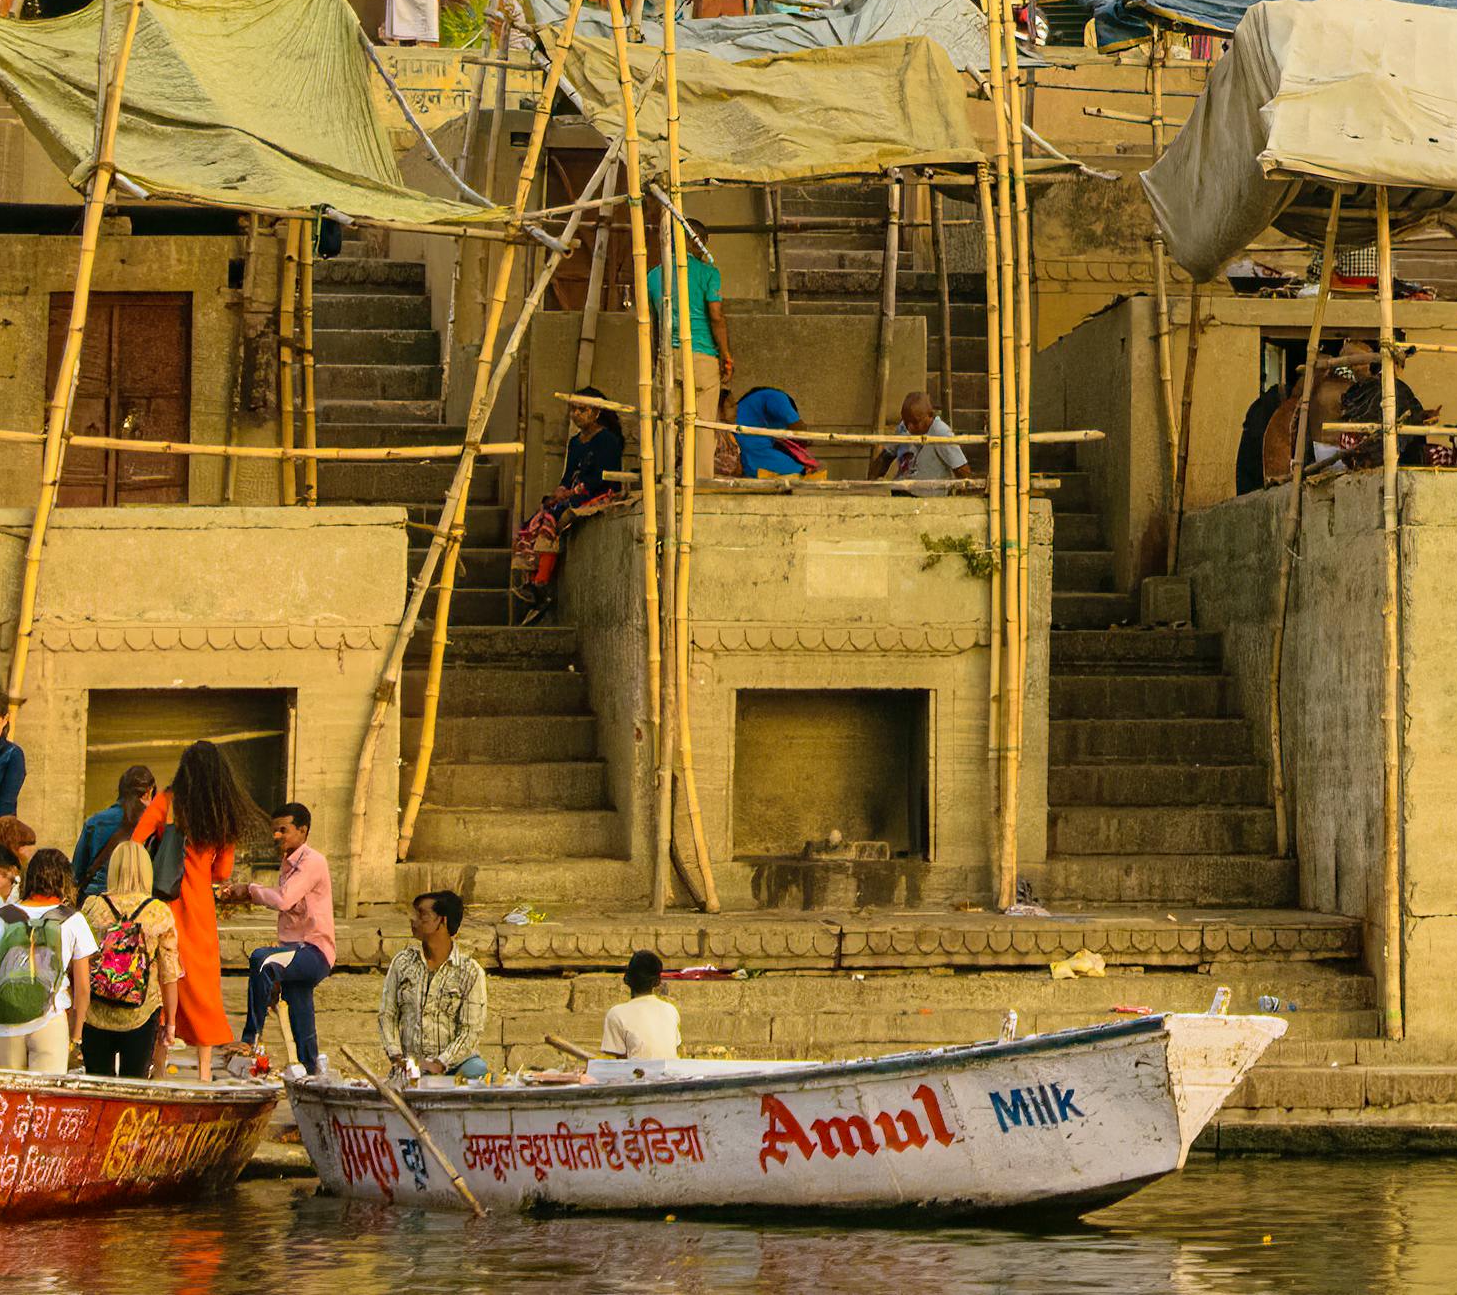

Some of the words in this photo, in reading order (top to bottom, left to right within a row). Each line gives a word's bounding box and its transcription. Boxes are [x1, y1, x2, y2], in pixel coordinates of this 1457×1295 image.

[463, 1134, 517, 1183] अमूल
[551, 1122, 601, 1170] पीता
[599, 1120, 623, 1171] है
[759, 1084, 955, 1174] Amul
